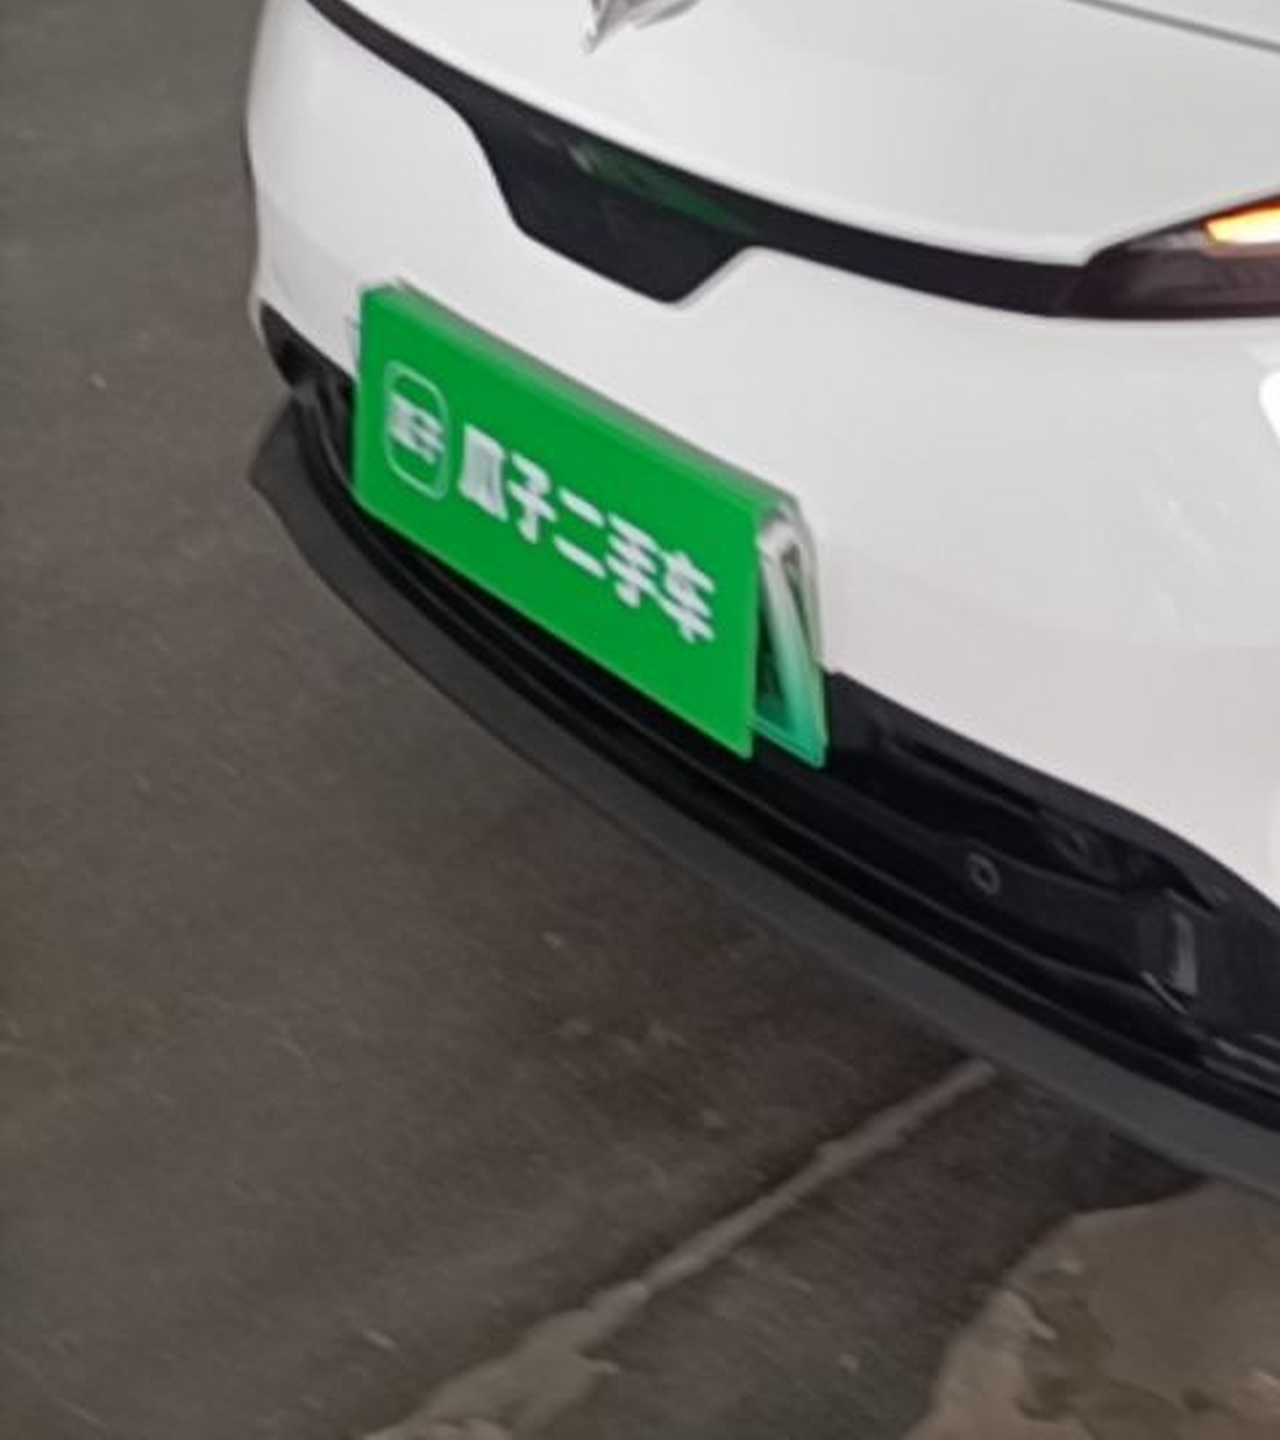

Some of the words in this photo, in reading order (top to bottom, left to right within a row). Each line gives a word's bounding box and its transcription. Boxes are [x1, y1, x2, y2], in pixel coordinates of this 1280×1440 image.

[457, 422, 716, 644] 瓜子二手车
